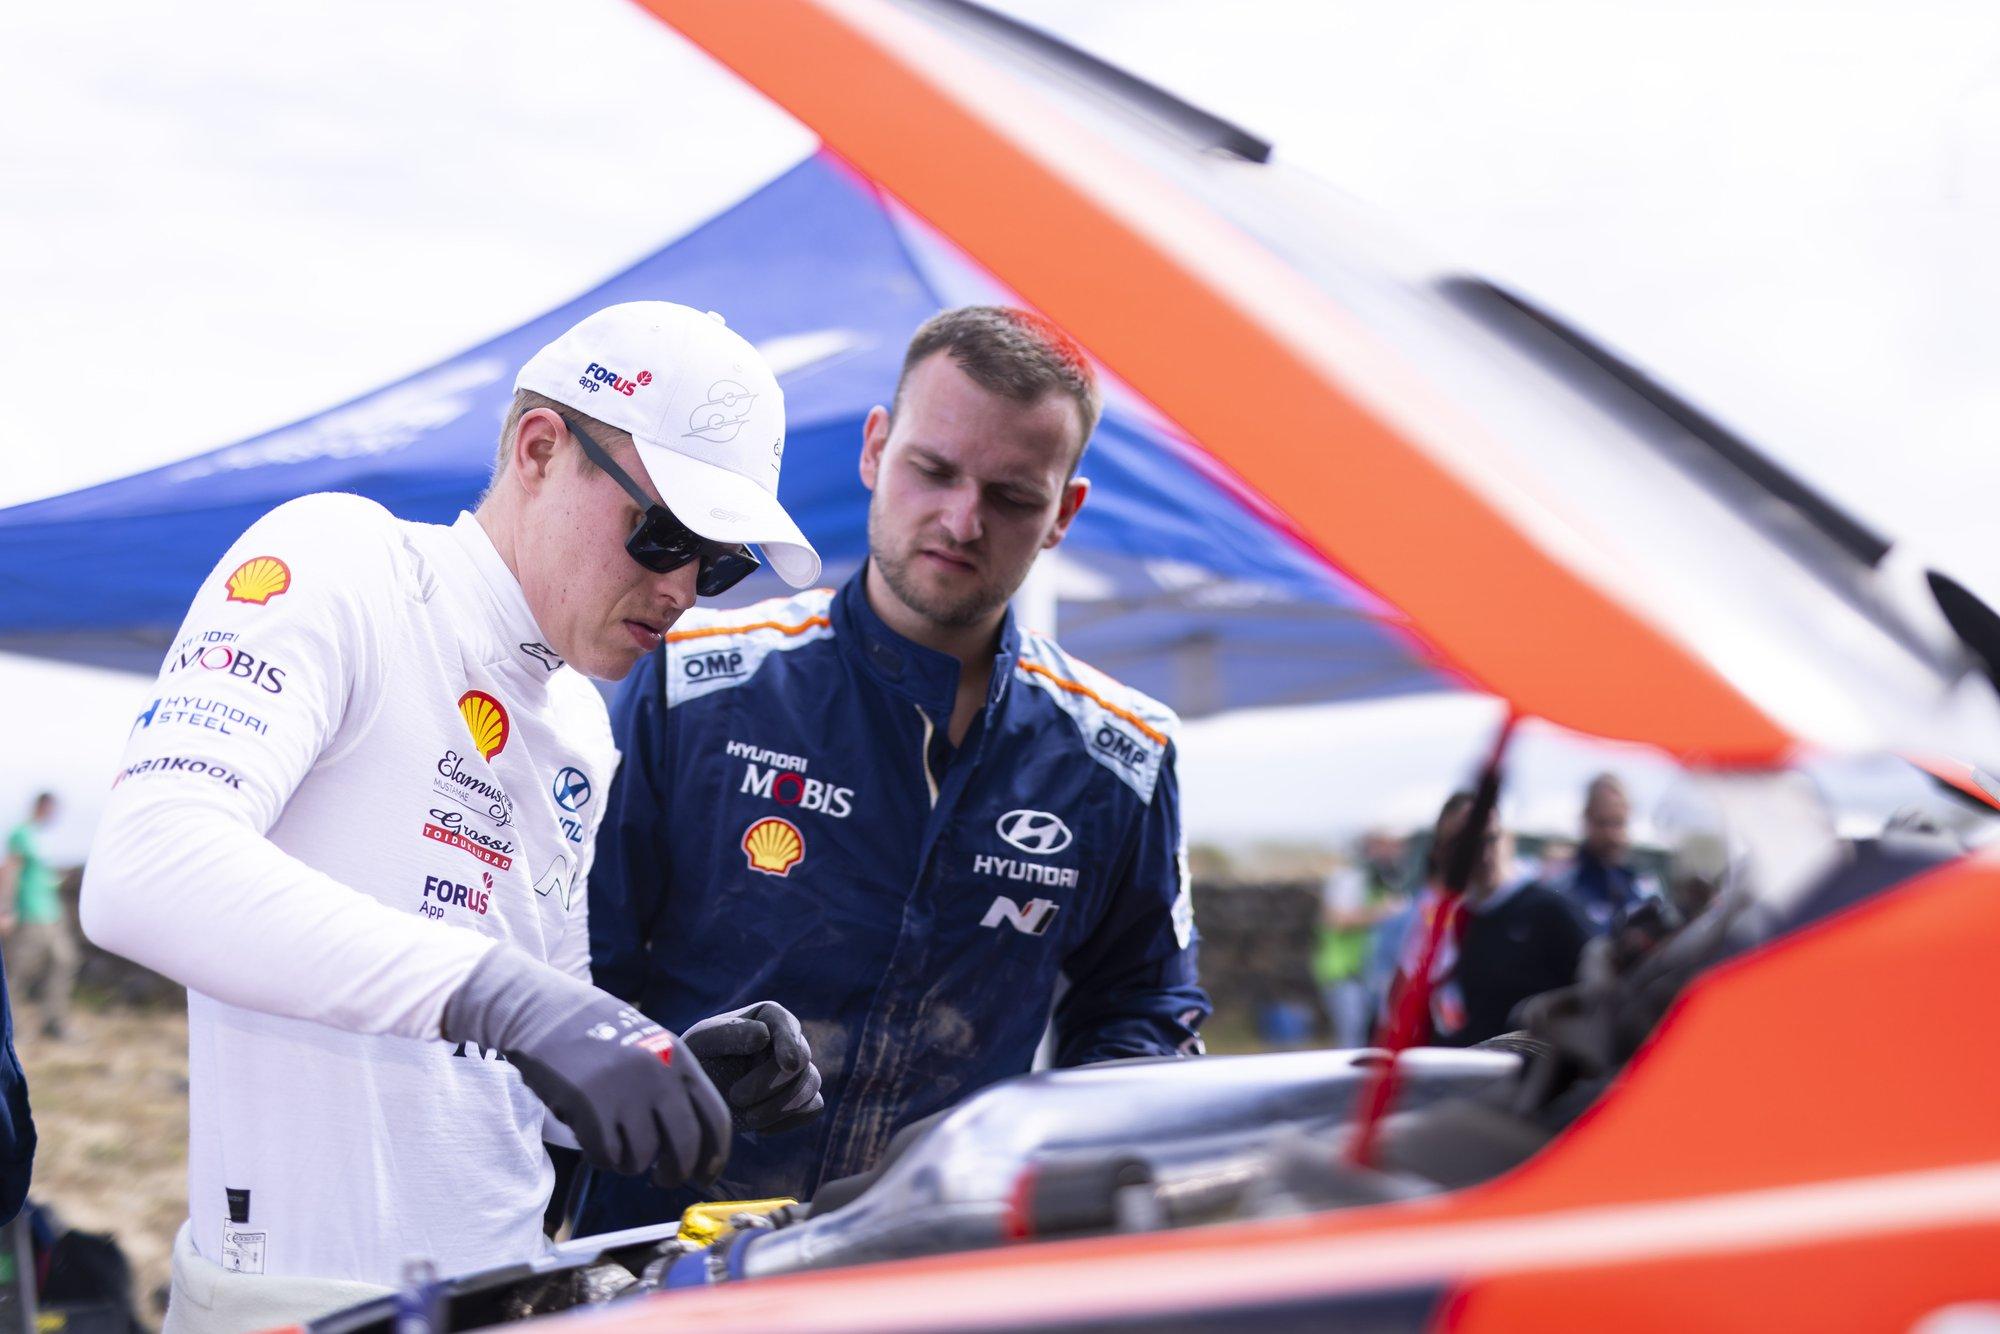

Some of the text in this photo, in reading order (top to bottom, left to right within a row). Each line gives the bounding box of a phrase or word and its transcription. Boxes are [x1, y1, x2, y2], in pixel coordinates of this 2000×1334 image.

[579, 376, 600, 393] app
[585, 362, 636, 396] FORUS
[170, 645, 287, 694] MOBIS
[684, 653, 743, 677] OMP
[158, 711, 231, 735] STEEL
[165, 696, 268, 735] HYUNDAI
[726, 740, 808, 773] HYUNDAI
[1096, 728, 1145, 765] OMP
[438, 750, 502, 802] Elamus
[740, 764, 855, 818] MOBIS
[430, 809, 514, 853] Grossi
[973, 855, 1079, 888] HYUNDAI
[419, 900, 444, 919] App
[423, 875, 489, 915] FORUS
